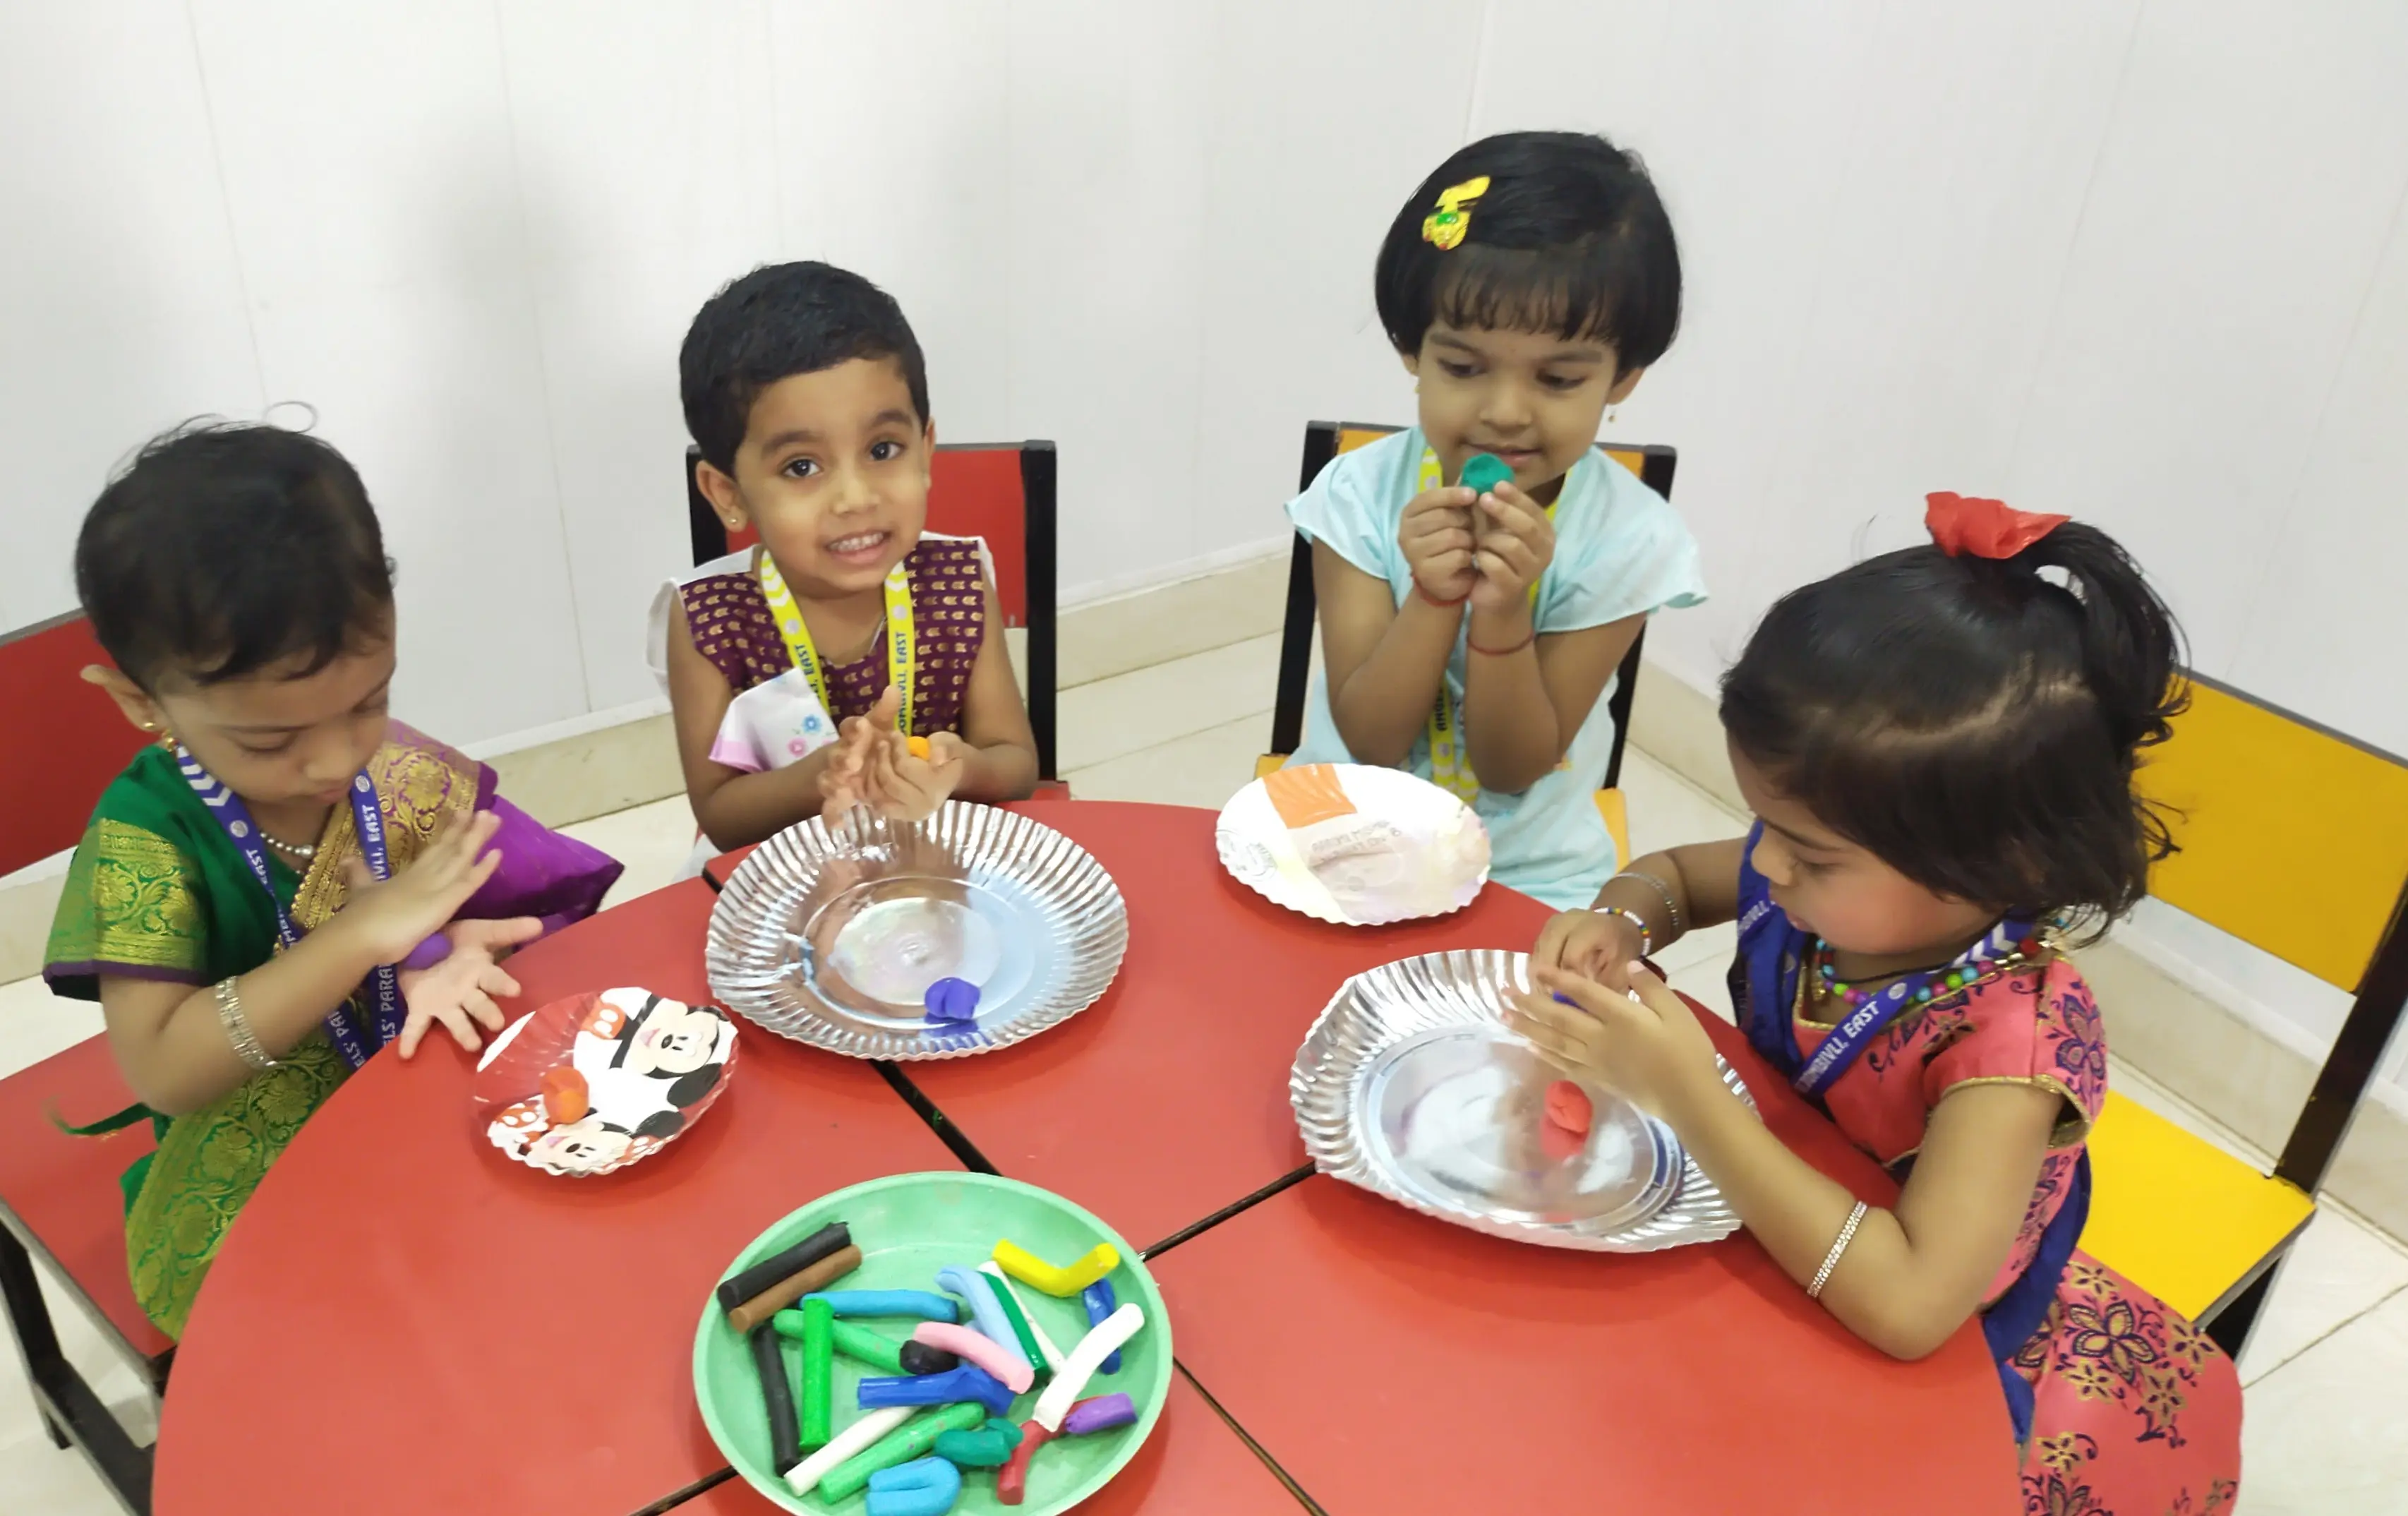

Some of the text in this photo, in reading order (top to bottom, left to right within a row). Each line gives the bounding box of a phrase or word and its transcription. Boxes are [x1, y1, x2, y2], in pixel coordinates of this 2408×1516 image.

[795, 644, 815, 675] EAST
[896, 632, 907, 664] EAST
[361, 805, 382, 843] EAST
[378, 963, 396, 1011] PARA
[1841, 1000, 1882, 1039] EAST
[342, 1041, 366, 1069] ELS'
